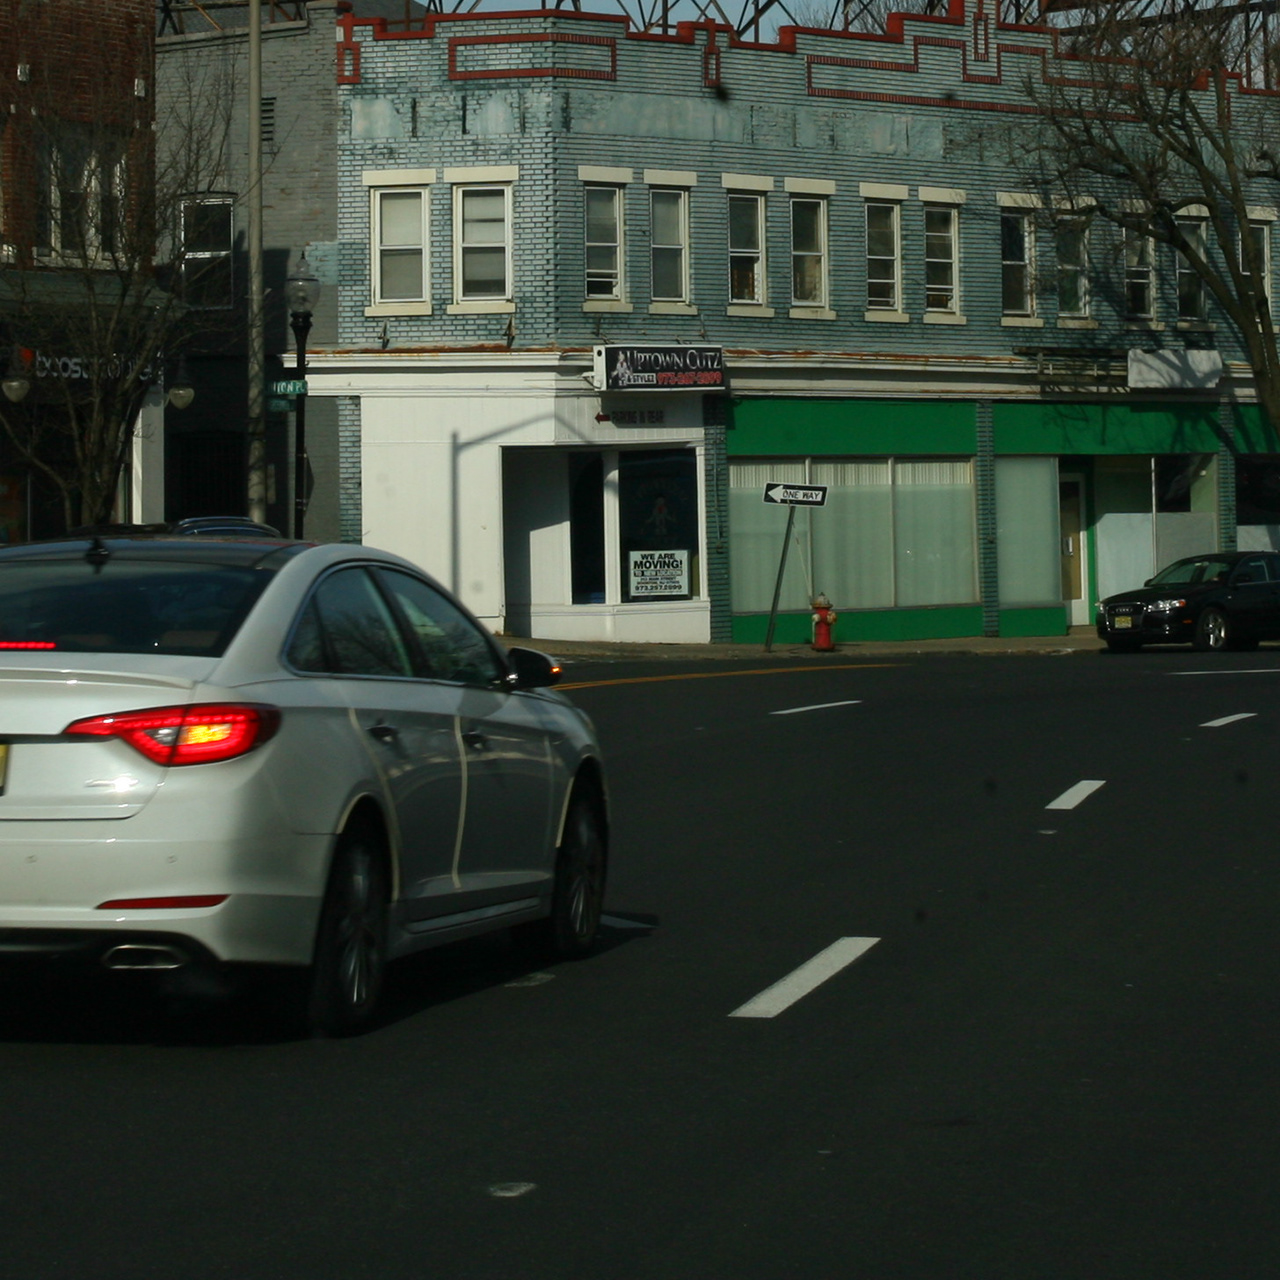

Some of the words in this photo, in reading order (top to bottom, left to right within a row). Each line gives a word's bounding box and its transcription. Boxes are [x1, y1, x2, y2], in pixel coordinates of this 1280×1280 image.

[783, 489, 800, 499] ONE
[802, 491, 820, 500] WAY
[634, 559, 682, 570] MOVING!
